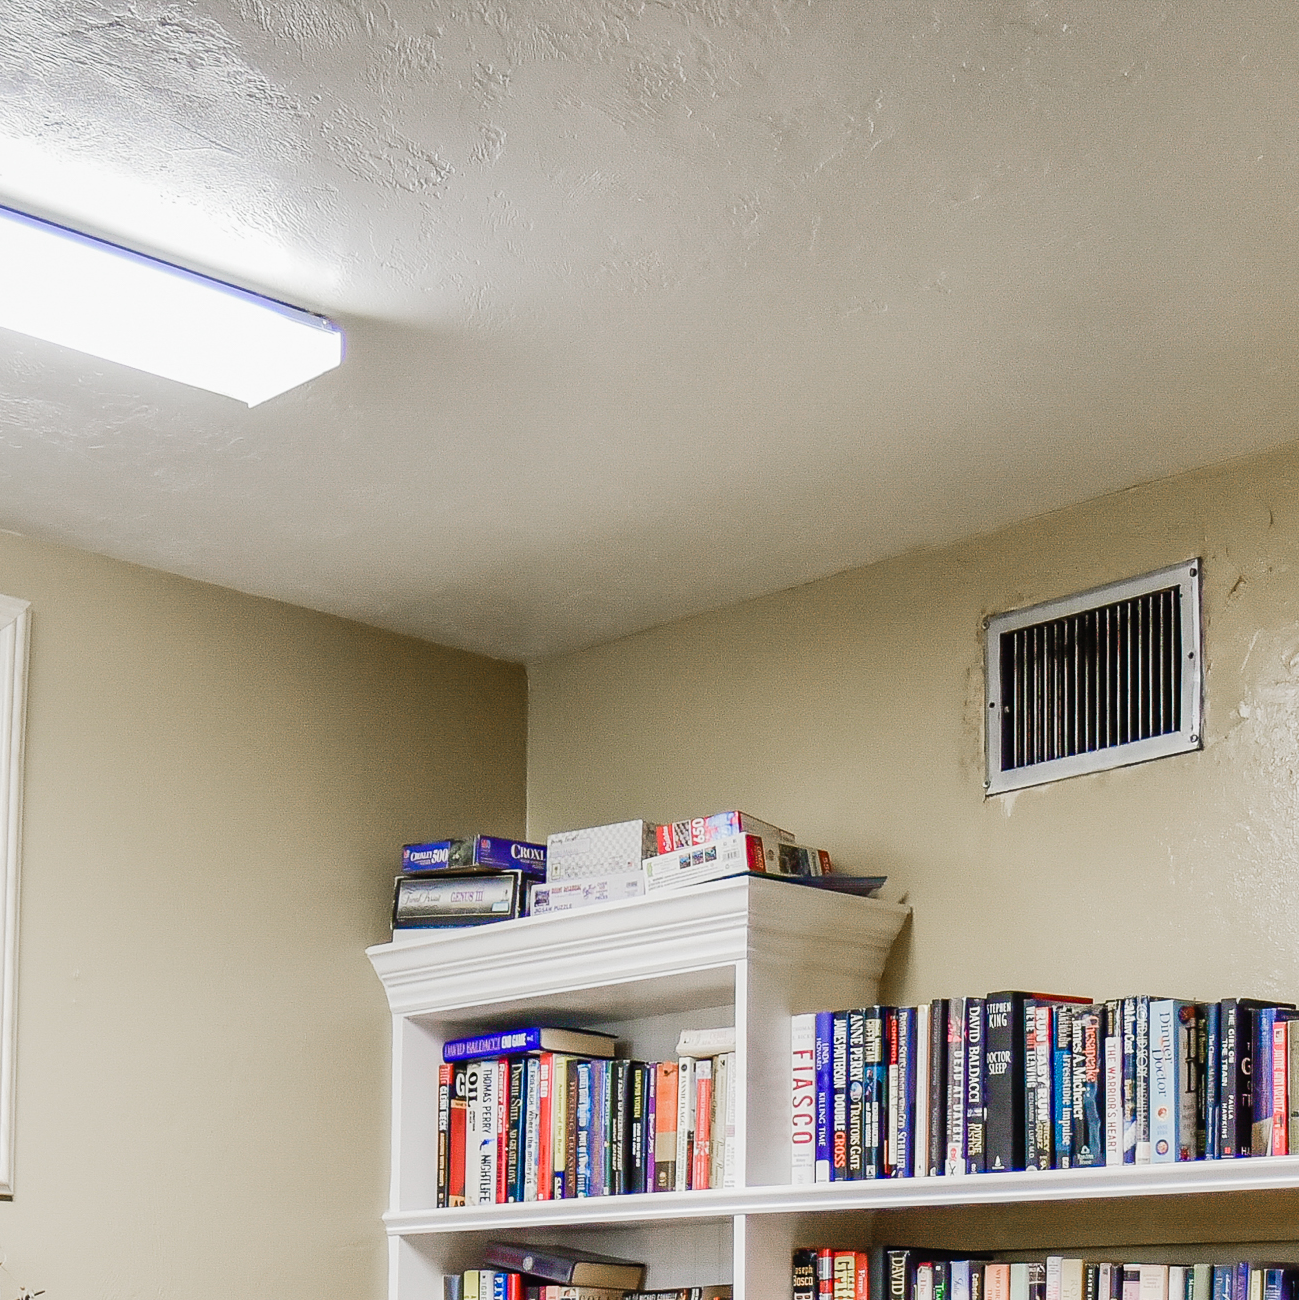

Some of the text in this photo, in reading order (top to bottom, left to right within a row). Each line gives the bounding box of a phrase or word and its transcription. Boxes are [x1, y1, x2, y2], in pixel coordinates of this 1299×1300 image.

[692, 818, 705, 843] 650
[989, 1013, 1008, 1028] KING
[1073, 1018, 1086, 1053] James
[1159, 1012, 1173, 1065] Dinner
[969, 1006, 980, 1103] DAVID BALDACCI
[1036, 1009, 1049, 1121] RUN BABY RUN
[1082, 1016, 1099, 1083] Chesapeake
[1151, 1048, 1168, 1098] Doctor
[1228, 1052, 1234, 1064] ON
[468, 1072, 478, 1107] OIL
[793, 1049, 813, 1144] FIASCO
[834, 1019, 846, 1168] JAMES PATTERSON DOUBLE CROSS
[850, 1014, 863, 1170] ANNE PERRY TRAITORS GATE
[1073, 1066, 1086, 1120] Michener
[1108, 1044, 1118, 1153] THE WARRIOR'S HEART
[480, 1069, 493, 1202] THOMAS PERRY NIGHTLIFE
[891, 1256, 905, 1295] DAVID
